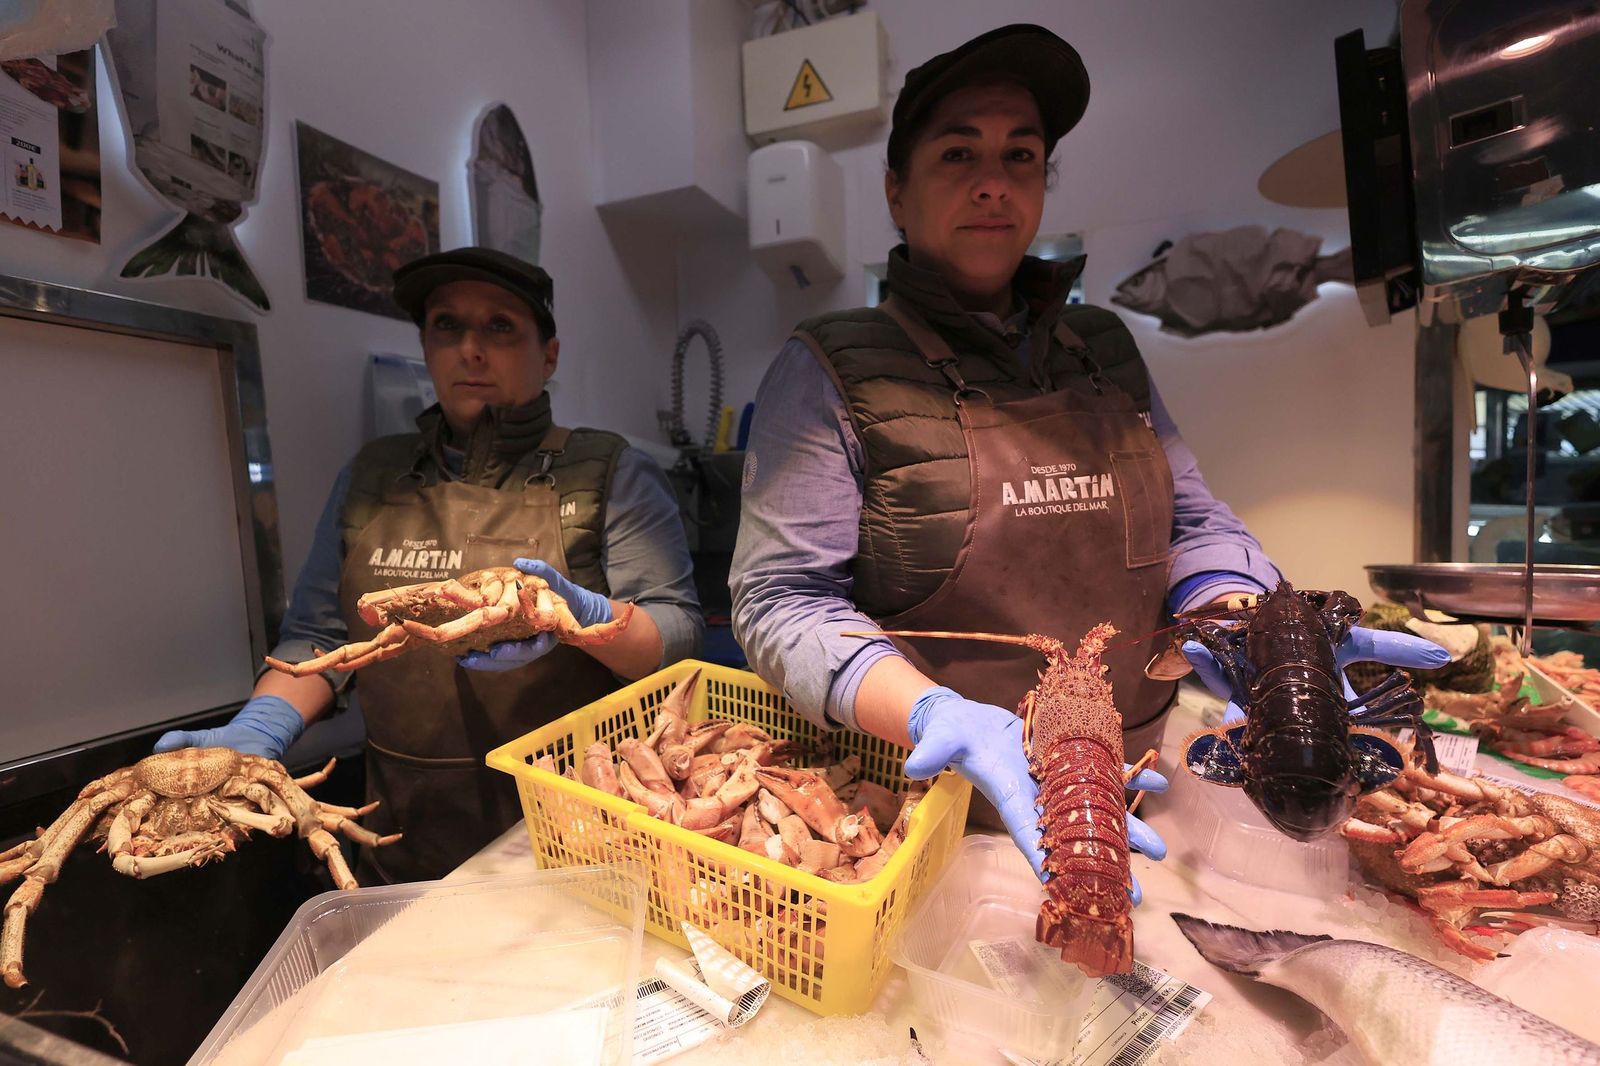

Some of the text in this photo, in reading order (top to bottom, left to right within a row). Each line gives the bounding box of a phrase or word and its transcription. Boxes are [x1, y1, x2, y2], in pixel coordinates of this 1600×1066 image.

[1030, 463, 1077, 474] DESDE 1970
[1015, 500, 1108, 517] LA BOUTIQUE DEL MAR
[374, 568, 449, 579] LA BOUTIQUE DEL MAR
